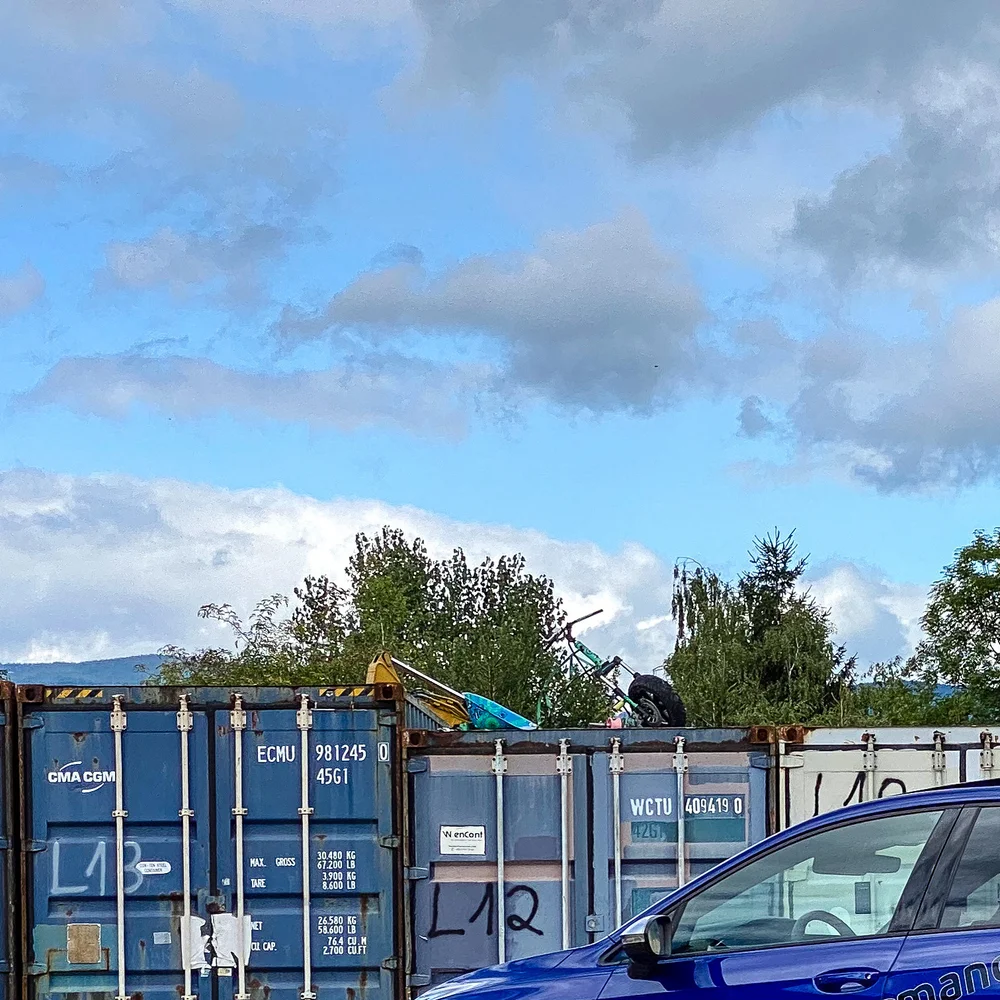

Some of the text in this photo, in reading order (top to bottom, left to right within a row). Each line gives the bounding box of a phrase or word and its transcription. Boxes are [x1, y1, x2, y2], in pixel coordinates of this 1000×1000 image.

[257, 743, 389, 763] ECMU 981245 0
[48, 771, 116, 783] CMA CGM
[316, 768, 348, 785] 45G1
[630, 797, 742, 816] WCTU 409419 0
[317, 851, 356, 860] 30.480 KG
[275, 857, 296, 867] GROSS
[317, 860, 356, 870] 67.200 LB
[322, 871, 357, 881] 3.900 KG
[251, 879, 266, 888] TARE
[322, 881, 356, 890] 8.600 LB
[428, 881, 544, 938] L12
[318, 916, 357, 925] 26.580 KG
[318, 925, 357, 934] 58.600 LB
[327, 937, 344, 946] 76.4
[262, 942, 278, 951] CAP.
[322, 946, 344, 955] 2.700
